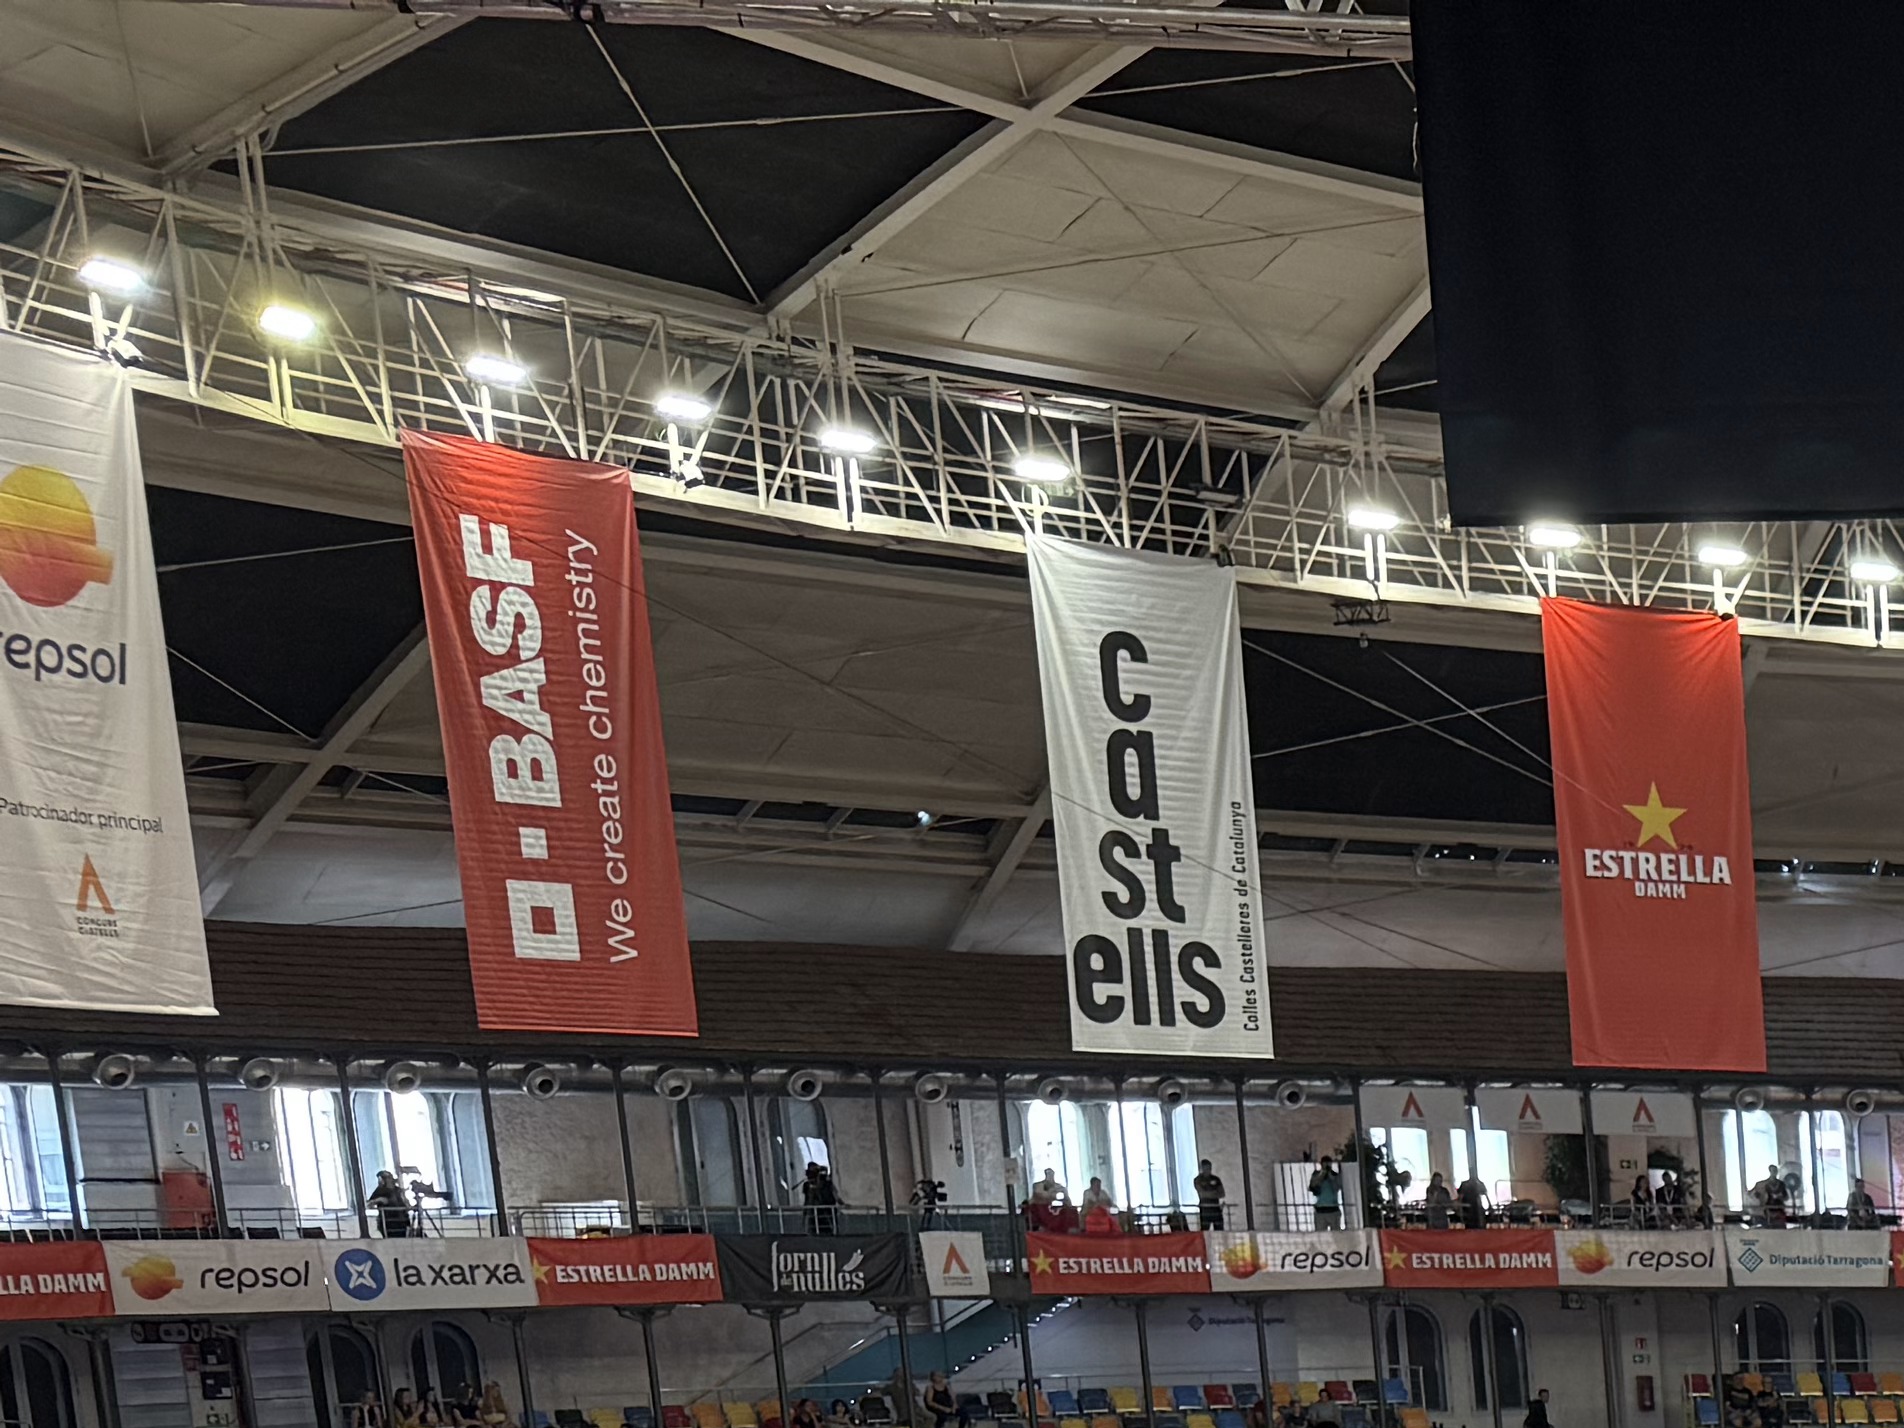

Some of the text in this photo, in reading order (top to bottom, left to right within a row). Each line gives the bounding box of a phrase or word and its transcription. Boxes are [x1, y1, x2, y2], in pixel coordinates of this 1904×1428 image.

[0, 633, 126, 684] epsol
[459, 513, 563, 810] BASF
[564, 529, 641, 964] We create chemistry
[98, 814, 164, 834] principal
[1229, 800, 1247, 875] Catalunya
[1583, 847, 1732, 886] ESTRELLA
[1233, 878, 1248, 897] de
[1633, 879, 1688, 900] DAMM
[1242, 989, 1259, 1032] Colles
[1058, 1256, 1202, 1275] ESTRELLA DAMM
[1280, 1246, 1371, 1272] repsol
[1412, 1253, 1552, 1269] ESTRELLA DAMM
[1627, 1248, 1714, 1272] repsol
[1769, 1254, 1884, 1268] Diputació Tarragona
[37, 1272, 106, 1293] DAMM
[200, 1260, 310, 1294] repsol
[394, 1258, 525, 1286] la xarxa
[555, 1262, 715, 1283] ESTRELLA DAMM
